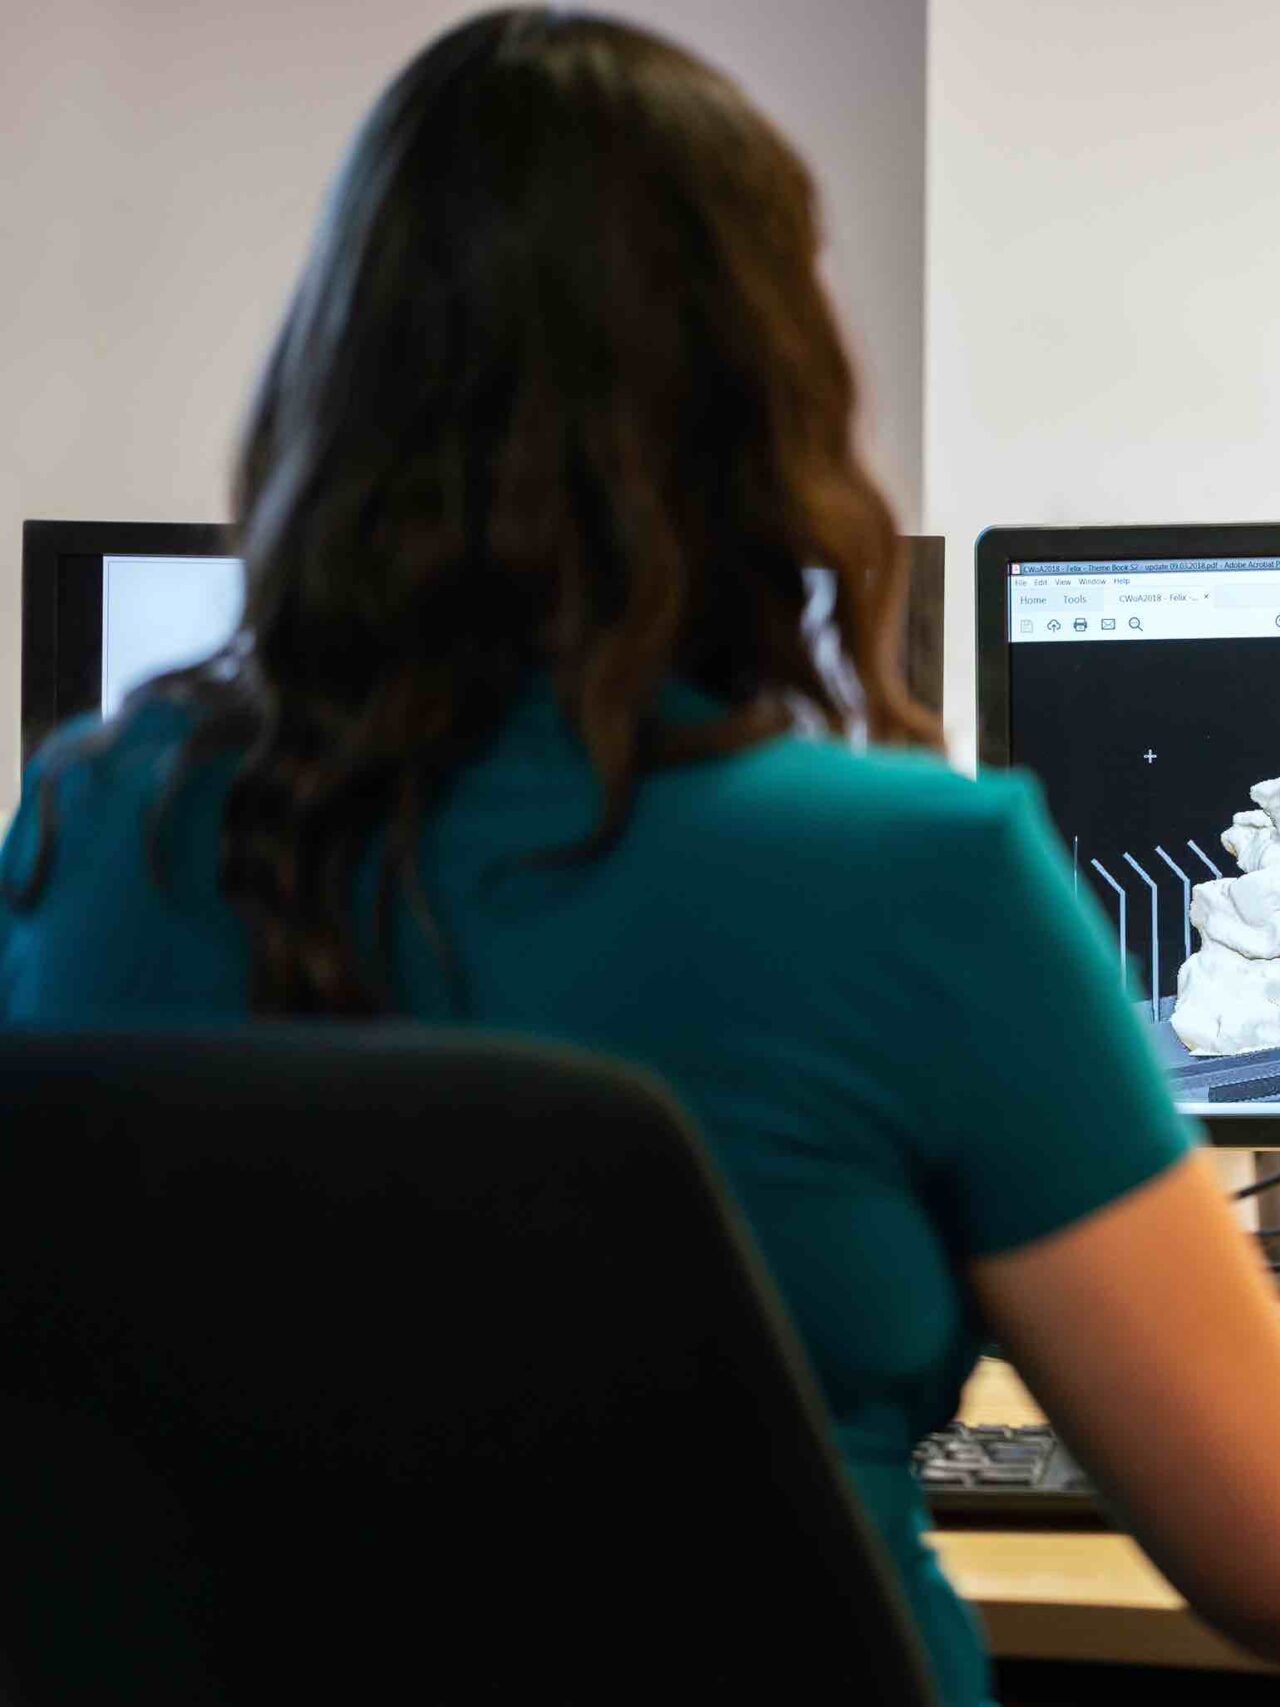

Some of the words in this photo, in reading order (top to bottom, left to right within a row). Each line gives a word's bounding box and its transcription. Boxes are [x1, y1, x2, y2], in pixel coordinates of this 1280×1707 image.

[1088, 564, 1110, 572] Theme
[1111, 563, 1128, 571] Book
[1144, 563, 1168, 571] update
[1224, 561, 1247, 569] Adobe
[1248, 560, 1274, 568] Acrobat
[1055, 578, 1071, 586] View
[1113, 577, 1130, 585] Help
[1020, 595, 1047, 605] Home
[1063, 594, 1087, 604] Tools
